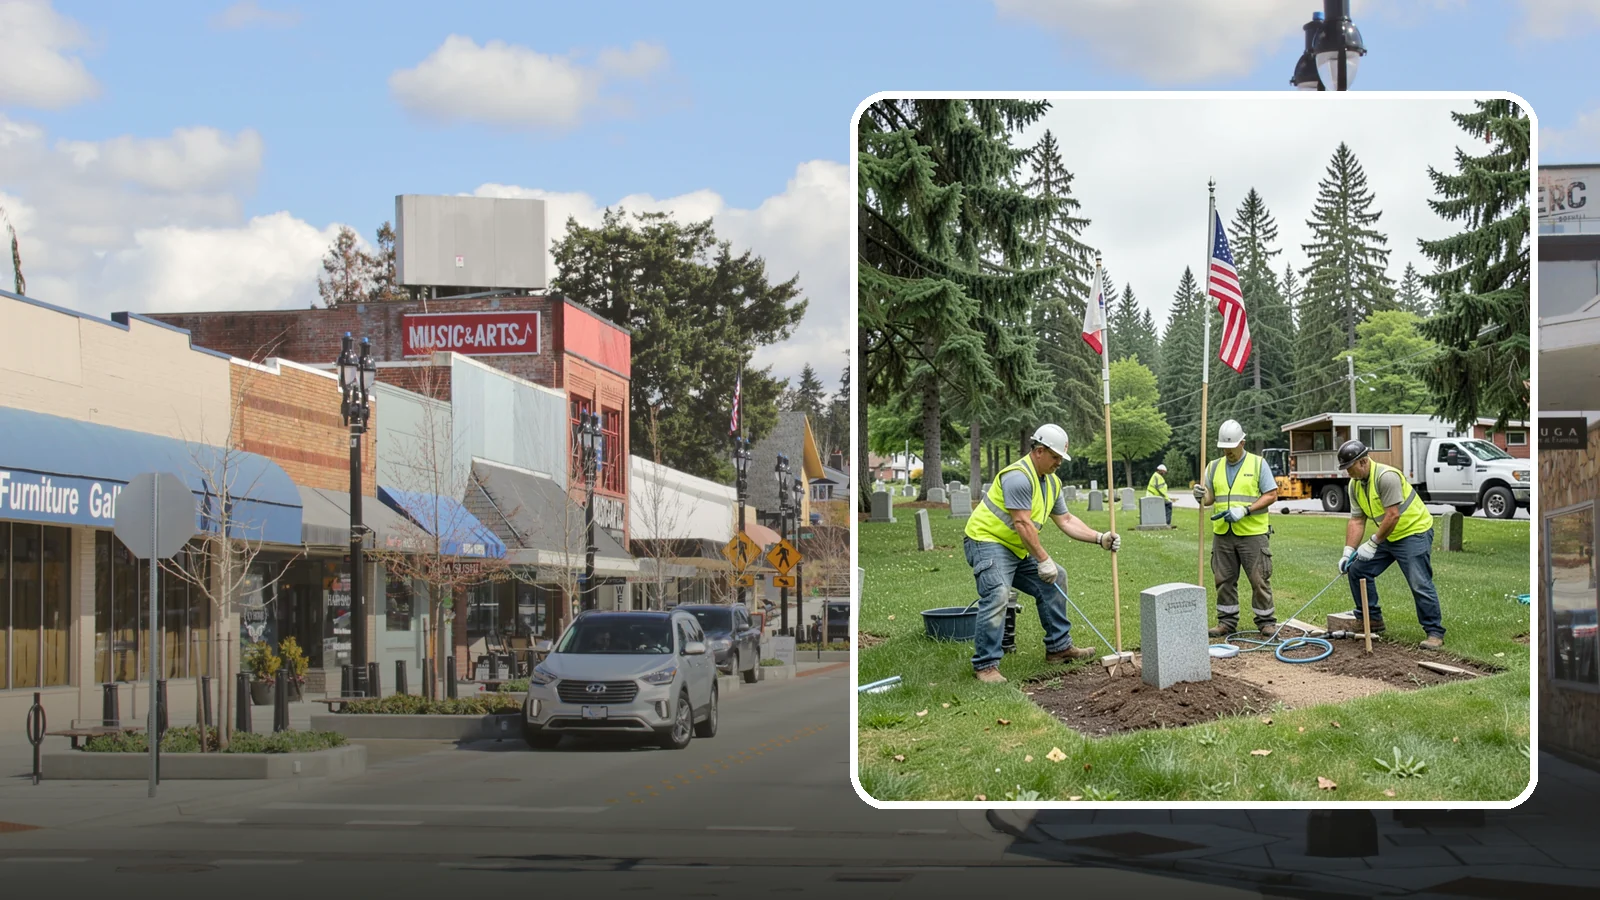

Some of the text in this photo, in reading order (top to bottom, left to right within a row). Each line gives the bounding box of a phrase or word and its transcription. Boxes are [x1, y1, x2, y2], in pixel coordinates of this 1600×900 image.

[408, 322, 520, 349] MUSIC&ARTS
[0, 471, 79, 515] Furniture
[453, 563, 479, 574] SUSHI
